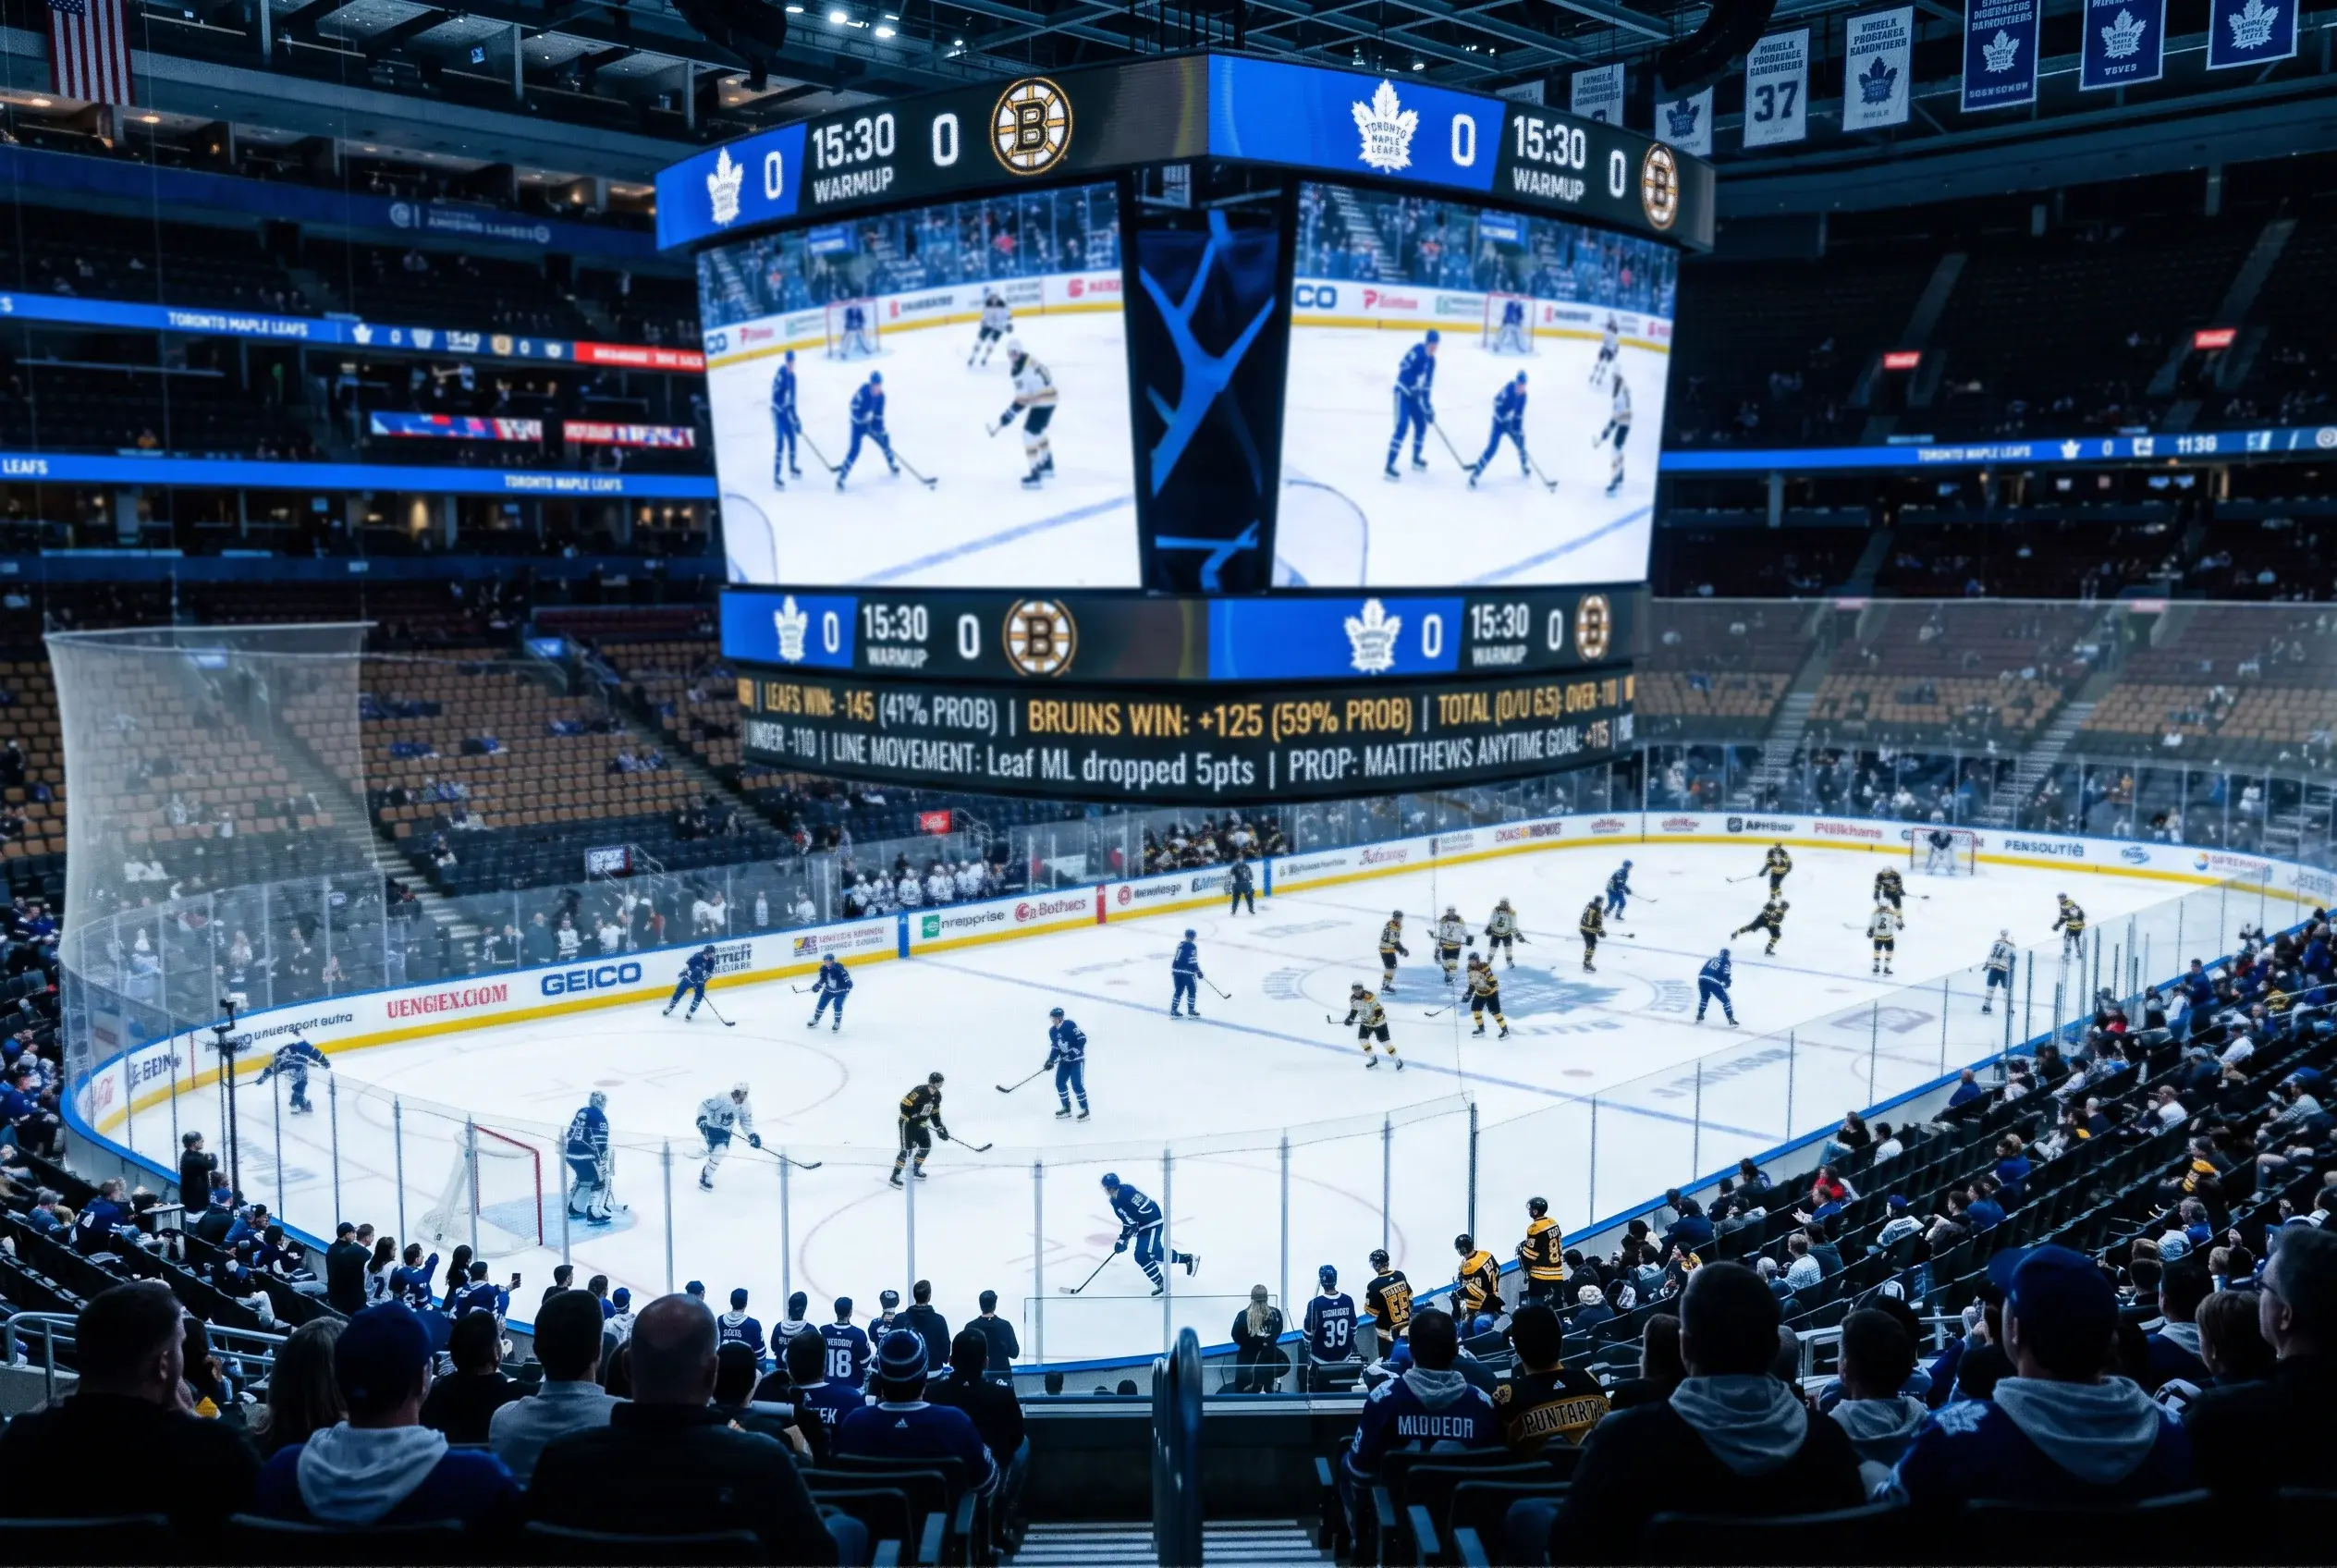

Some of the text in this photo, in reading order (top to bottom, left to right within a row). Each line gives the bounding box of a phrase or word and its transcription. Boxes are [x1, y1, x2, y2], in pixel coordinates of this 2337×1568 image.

[1754, 80, 1799, 123] 37
[813, 113, 895, 171] 15:30
[932, 113, 960, 166] 0
[1451, 114, 1476, 167] 0
[1513, 115, 1586, 170] 15:30
[1609, 150, 1626, 199] 0
[814, 166, 894, 204] WARMUP
[1513, 166, 1585, 204] WARMUP
[167, 312, 309, 337] TORONTO MAPLE LEAFS
[2, 459, 48, 474] LEAFS
[1917, 444, 2032, 463] TORONTO MAPLE LEAFS
[505, 474, 622, 493] TORONTO MAPLE LEAFS
[823, 611, 840, 654] 0
[863, 604, 928, 642] 15:30
[958, 614, 981, 659] 0
[1422, 613, 1442, 658] 0
[1471, 603, 1529, 640] 15:30
[1548, 609, 1563, 651] 0
[866, 645, 928, 668] WARMUP
[1472, 645, 1527, 667] WARMUP
[838, 690, 875, 722] -145
[879, 691, 928, 727] (41%
[934, 696, 998, 736] PROB)
[1028, 701, 1121, 735] BRUINS
[1129, 704, 1190, 735] WIN:
[1198, 703, 1264, 738] +125
[1272, 702, 1340, 741] (59%
[1346, 697, 1413, 736] PROB)
[1438, 690, 1491, 726] TOTAL
[833, 732, 867, 764] LINE
[871, 736, 982, 775] MOVEMENT:
[988, 745, 1036, 778] Leaf
[1042, 750, 1075, 780] ML
[1083, 752, 1187, 791] dropped
[1195, 753, 1255, 791] 5pts
[1289, 748, 1359, 782] PROP:
[1364, 739, 1474, 778] MATTHEWS
[1477, 730, 1544, 766] ANYTIME
[541, 962, 642, 996] GEICO
[1323, 1318, 1349, 1348] 39
[827, 1349, 852, 1378] 18
